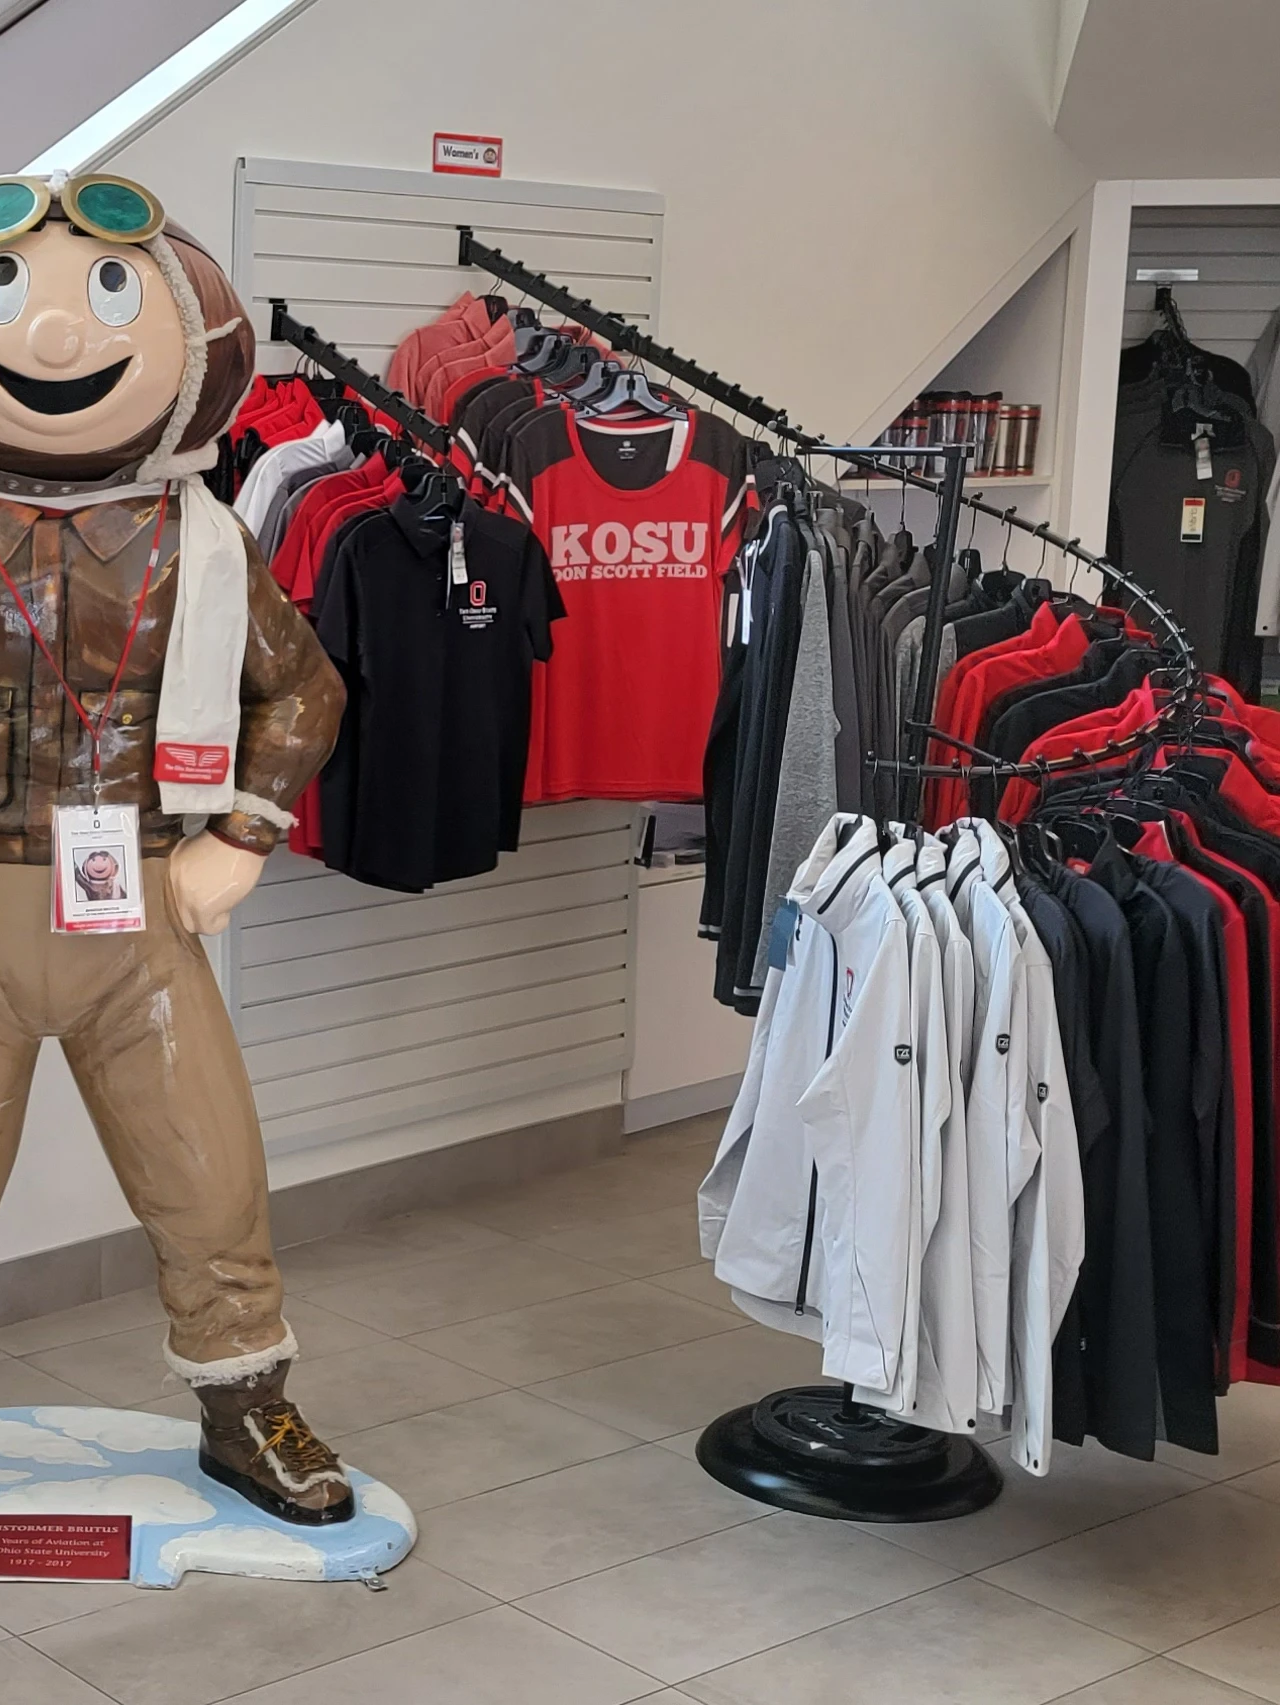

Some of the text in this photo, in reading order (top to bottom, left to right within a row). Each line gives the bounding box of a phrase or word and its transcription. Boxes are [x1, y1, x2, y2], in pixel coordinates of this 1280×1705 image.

[442, 144, 479, 160] Women's
[550, 521, 708, 568] KOSU
[591, 564, 653, 579] SCOTT
[656, 563, 708, 579] FIELD
[45, 1538, 90, 1546] Aviation
[24, 1547, 53, 1555] State
[55, 1549, 110, 1558] University
[10, 1558, 35, 1566] 1917
